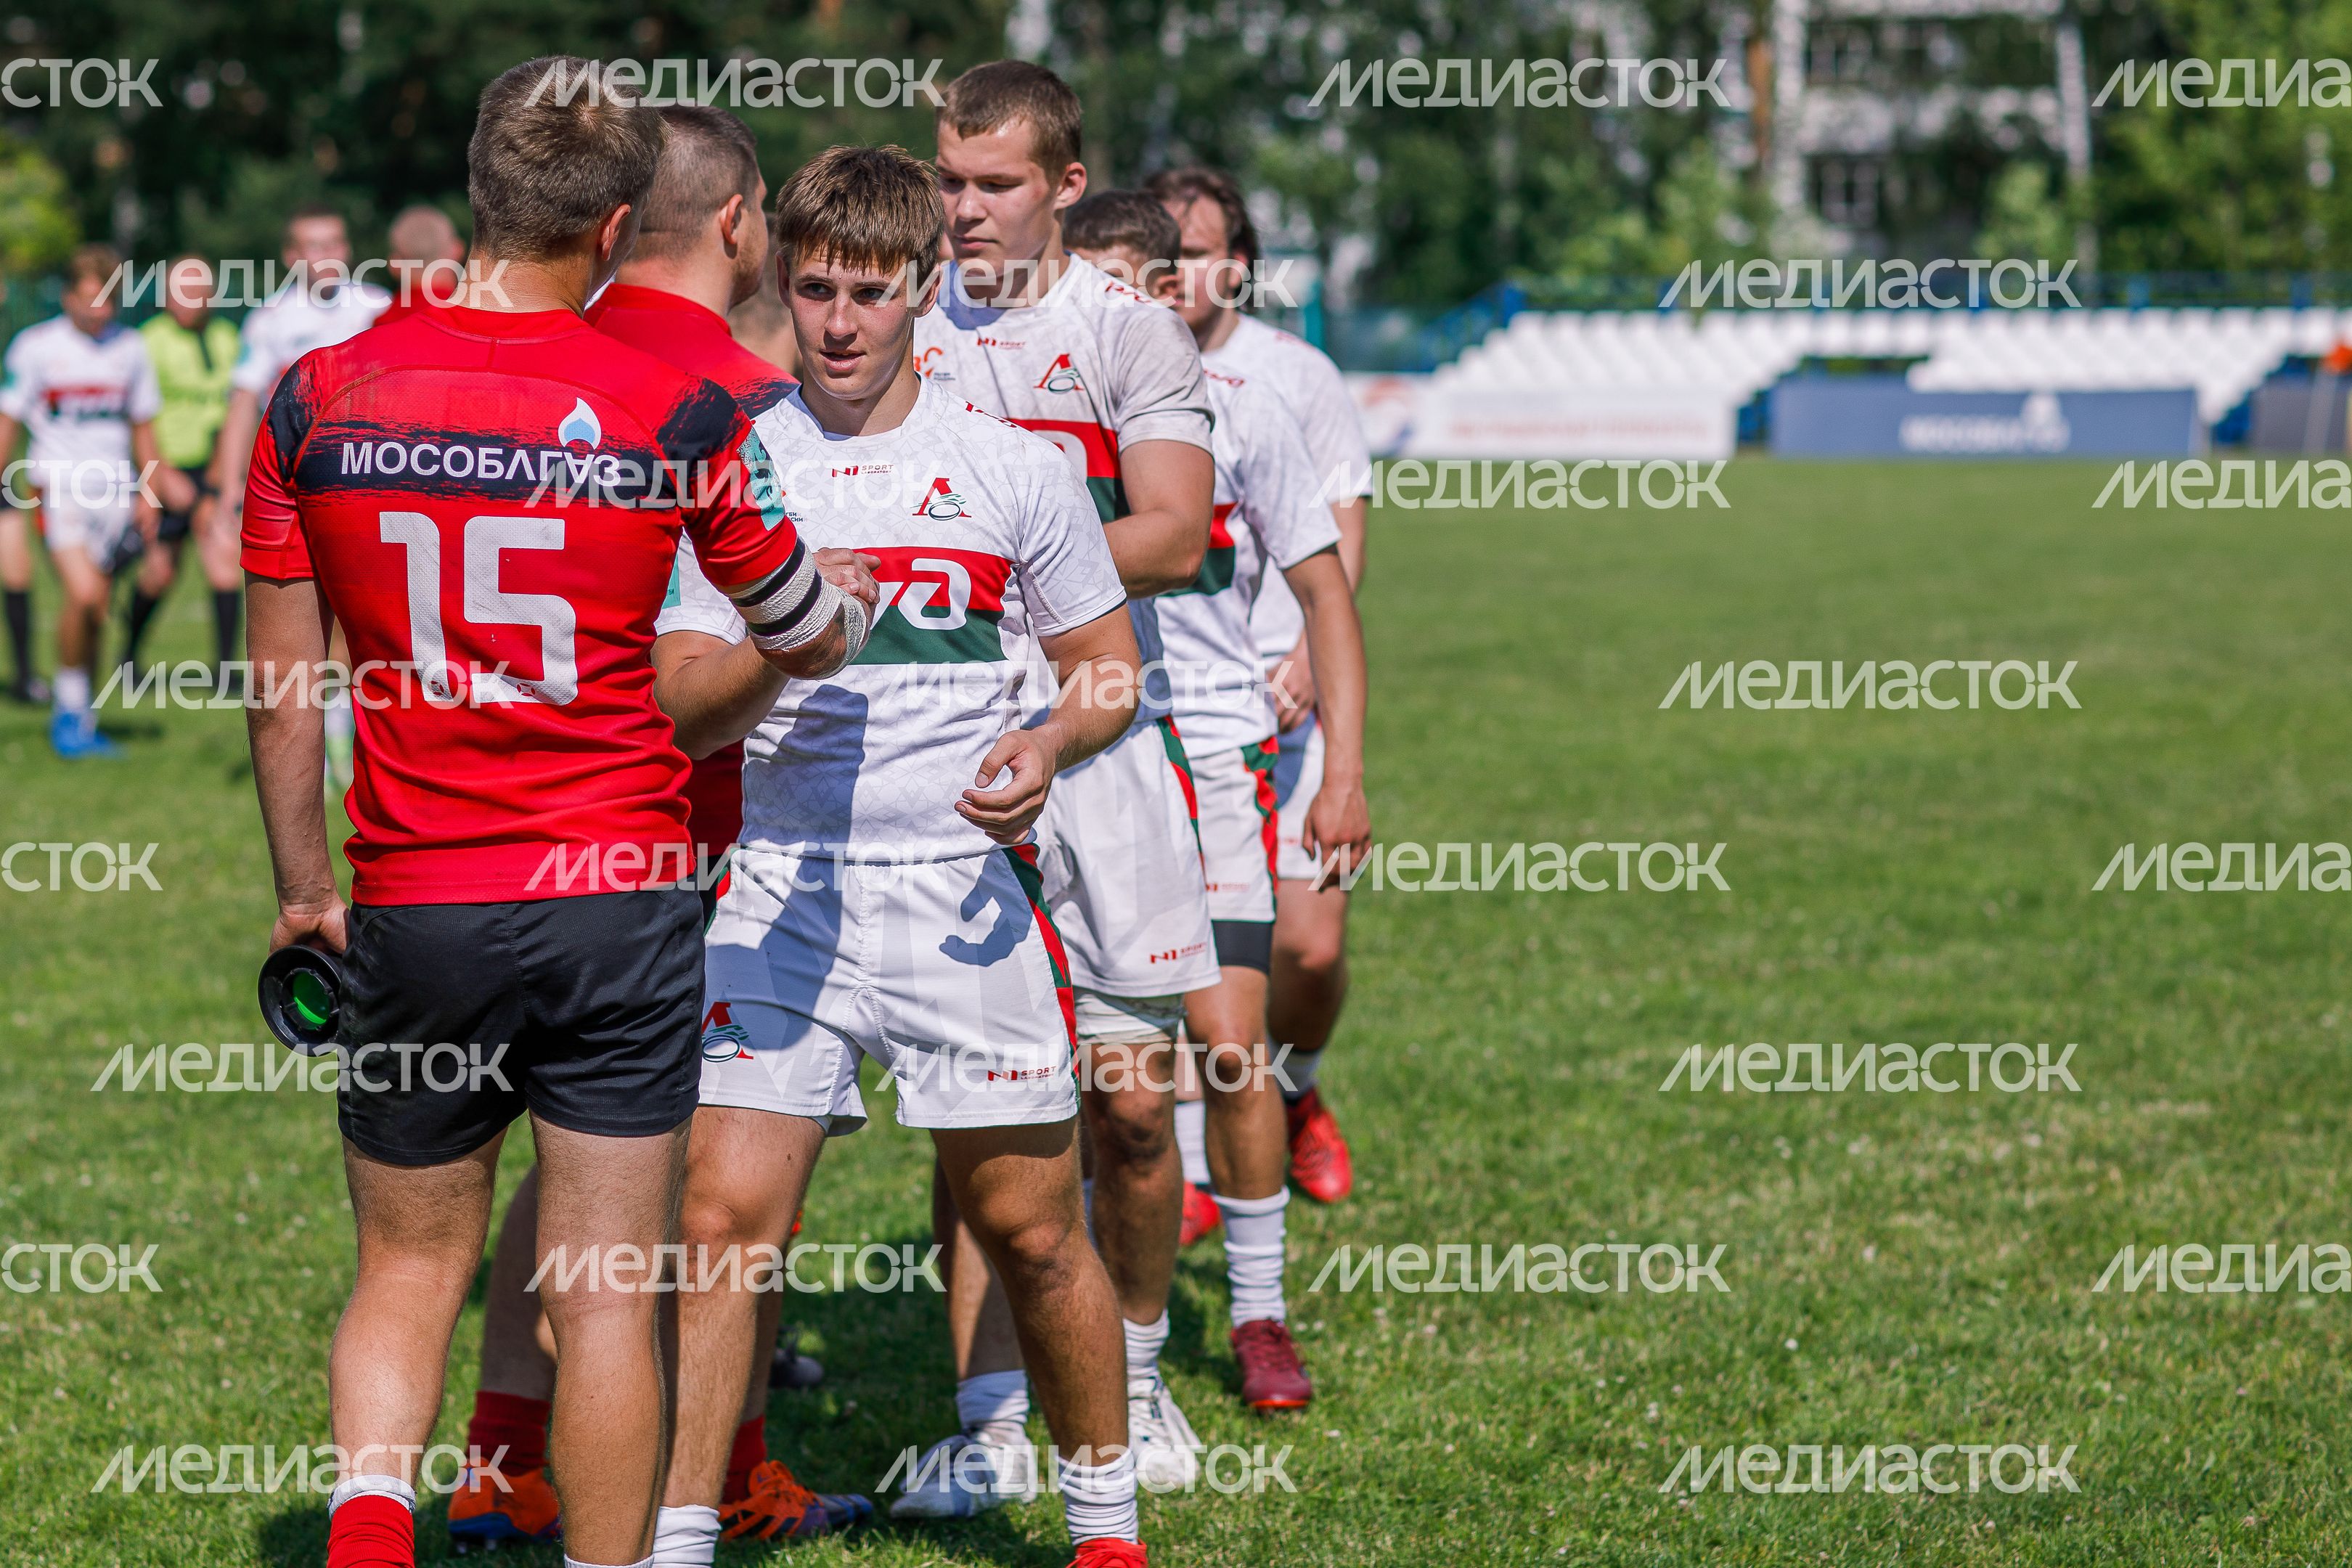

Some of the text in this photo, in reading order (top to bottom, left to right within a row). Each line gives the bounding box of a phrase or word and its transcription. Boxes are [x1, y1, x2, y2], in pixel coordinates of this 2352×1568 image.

[341, 441, 621, 487] МОСОБЛГАЗ
[379, 511, 579, 706] 15
[1021, 1066, 1056, 1076] SPORT
